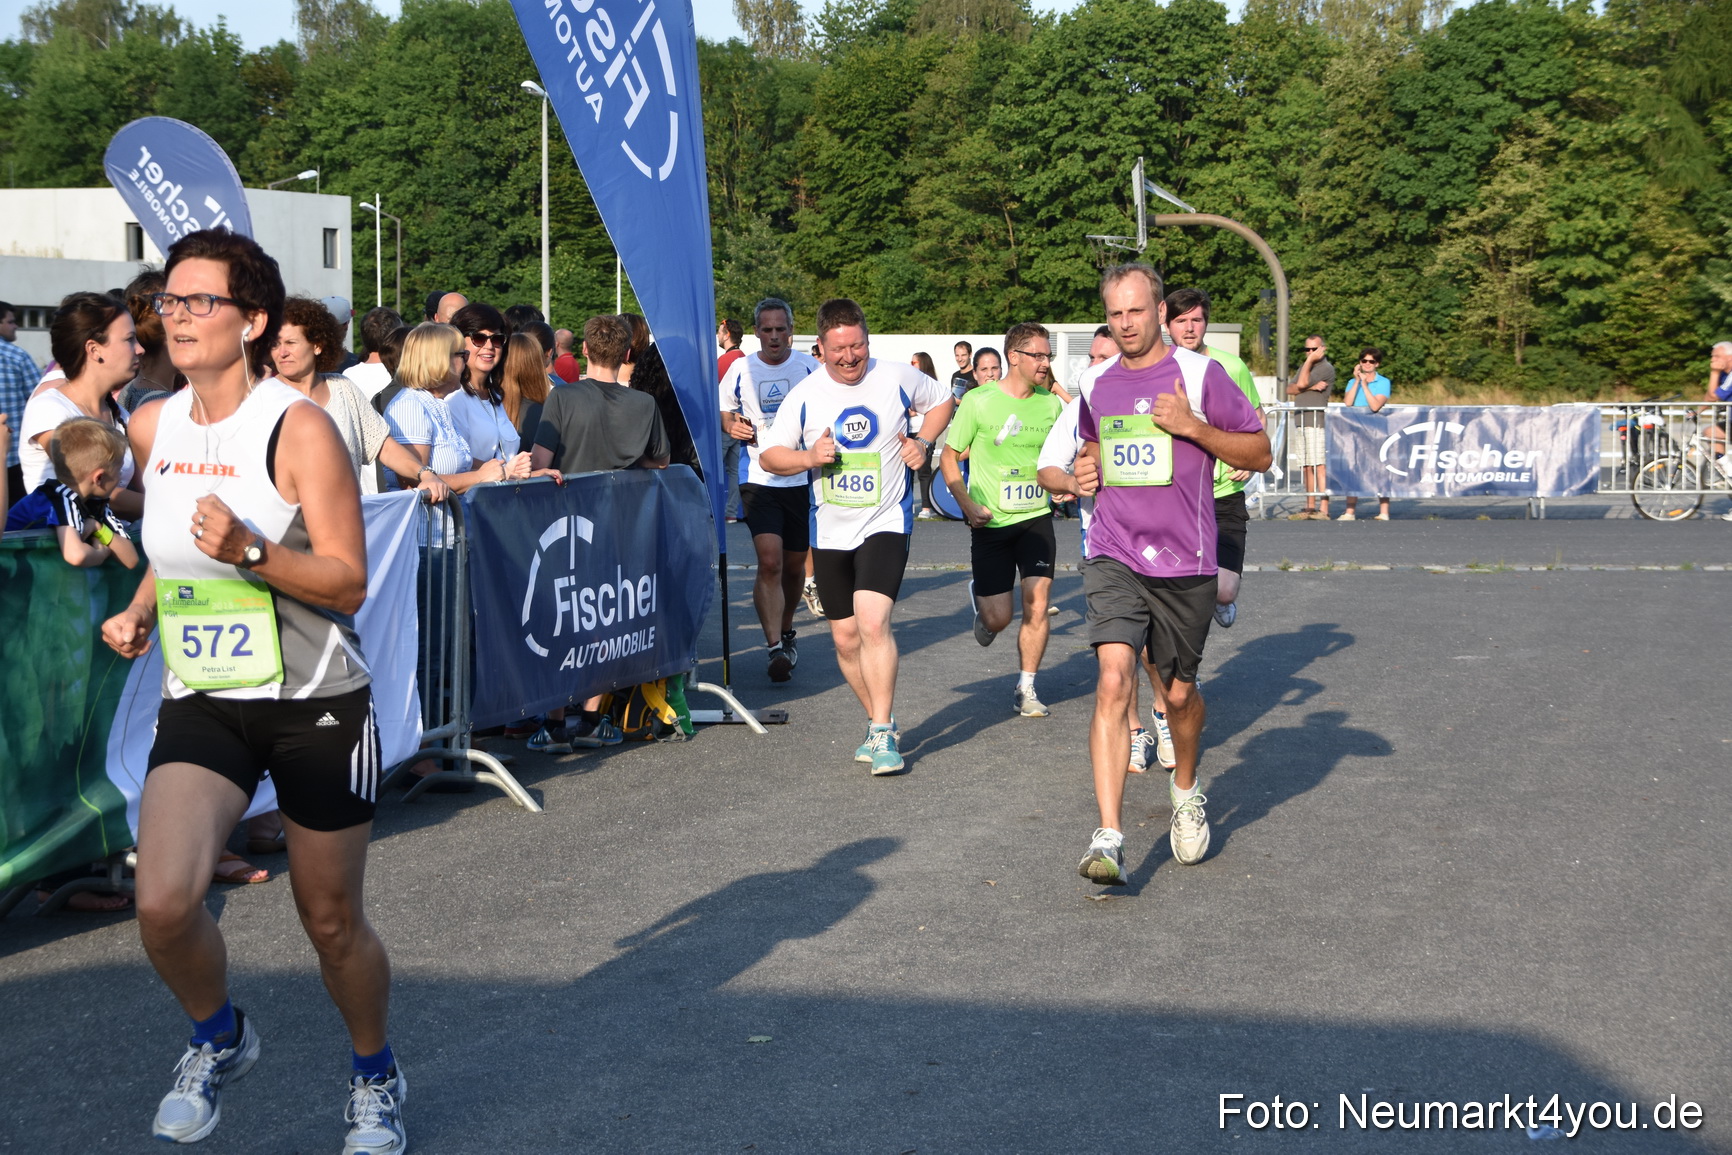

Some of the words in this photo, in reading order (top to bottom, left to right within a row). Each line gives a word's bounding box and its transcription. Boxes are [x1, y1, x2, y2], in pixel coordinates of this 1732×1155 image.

[845, 420, 868, 432] TÜV
[1113, 443, 1156, 467] 503
[1408, 443, 1543, 469] Fischer
[173, 462, 241, 478] KLEBL
[1420, 471, 1532, 484] AUTOMOBILE
[827, 473, 875, 492] 1486
[1004, 484, 1044, 500] 1100
[172, 597, 210, 607] firmenlauf
[182, 623, 254, 659] 572
[559, 625, 656, 671] AUTOMOBILE
